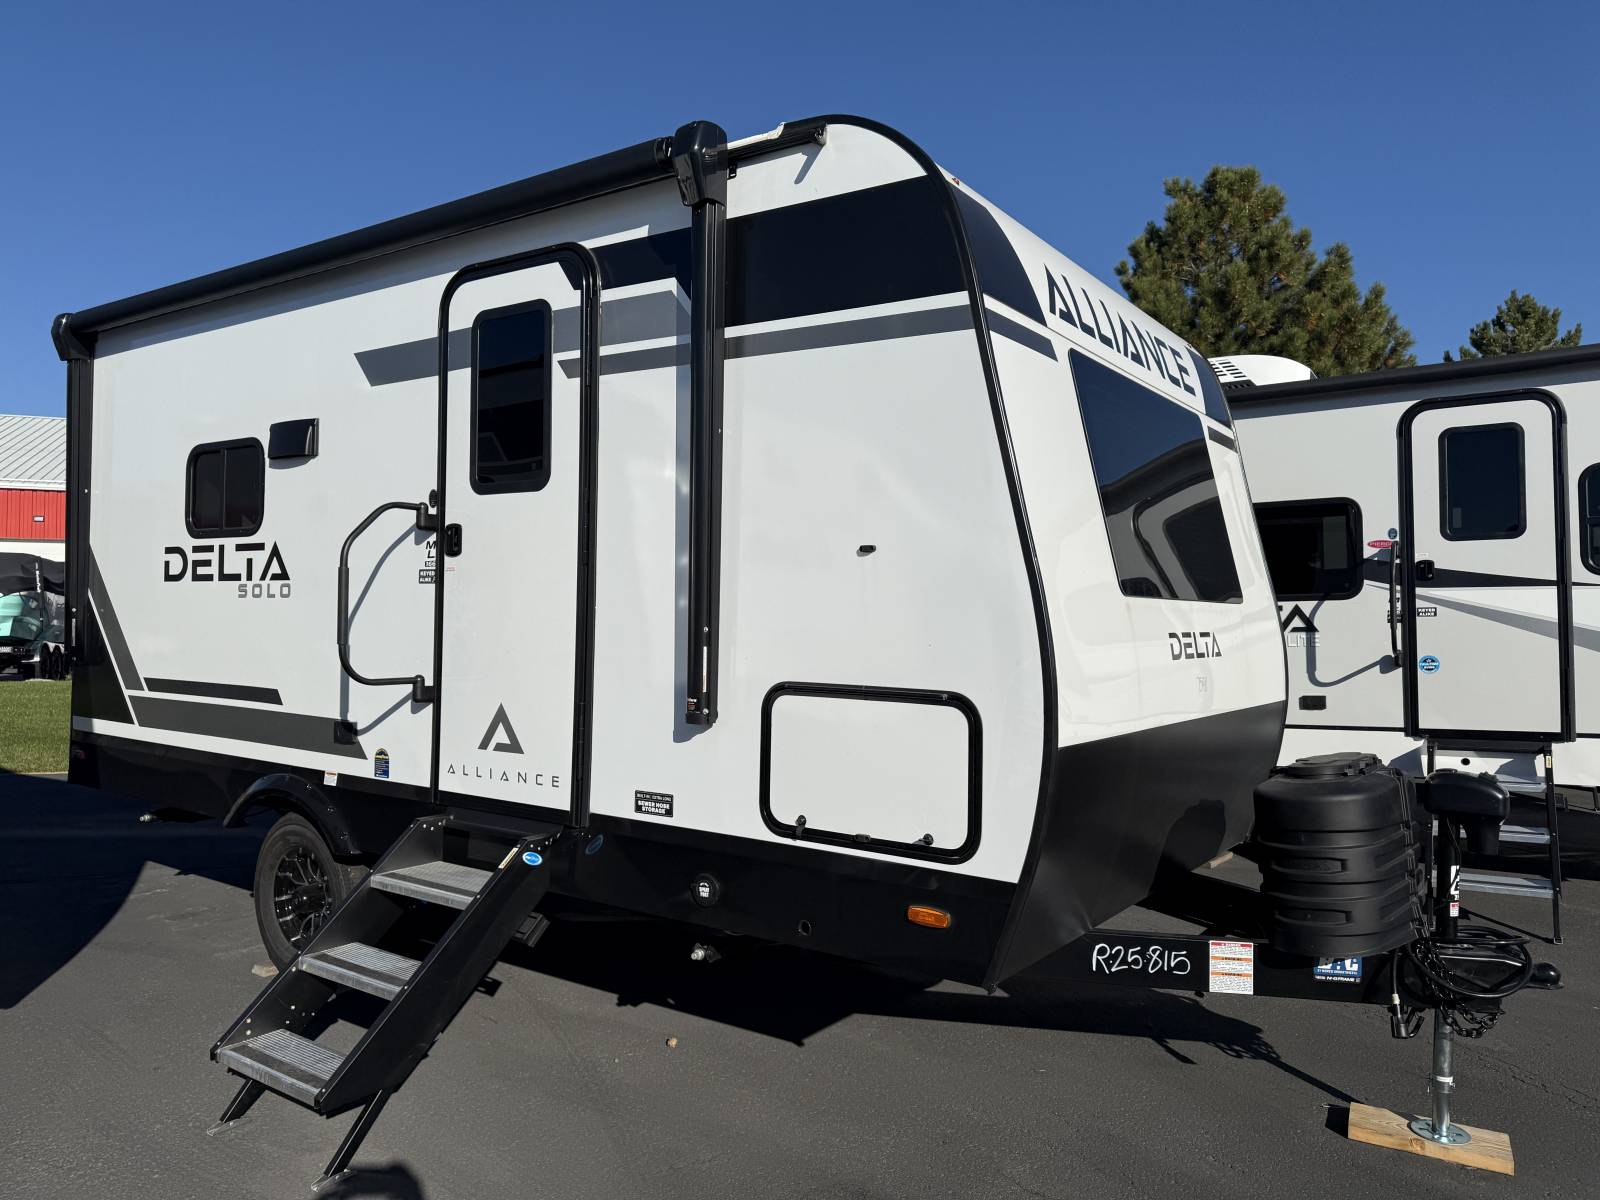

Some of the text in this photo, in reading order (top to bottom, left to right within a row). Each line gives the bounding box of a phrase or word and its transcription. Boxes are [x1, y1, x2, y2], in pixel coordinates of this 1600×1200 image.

[1044, 263, 1196, 397] ALLIANCE
[164, 541, 290, 582] DELTA
[238, 583, 291, 599] SOLO
[1168, 631, 1222, 660] DELTA
[447, 763, 560, 788] ALLIANCE
[641, 806, 665, 814] STORAGE
